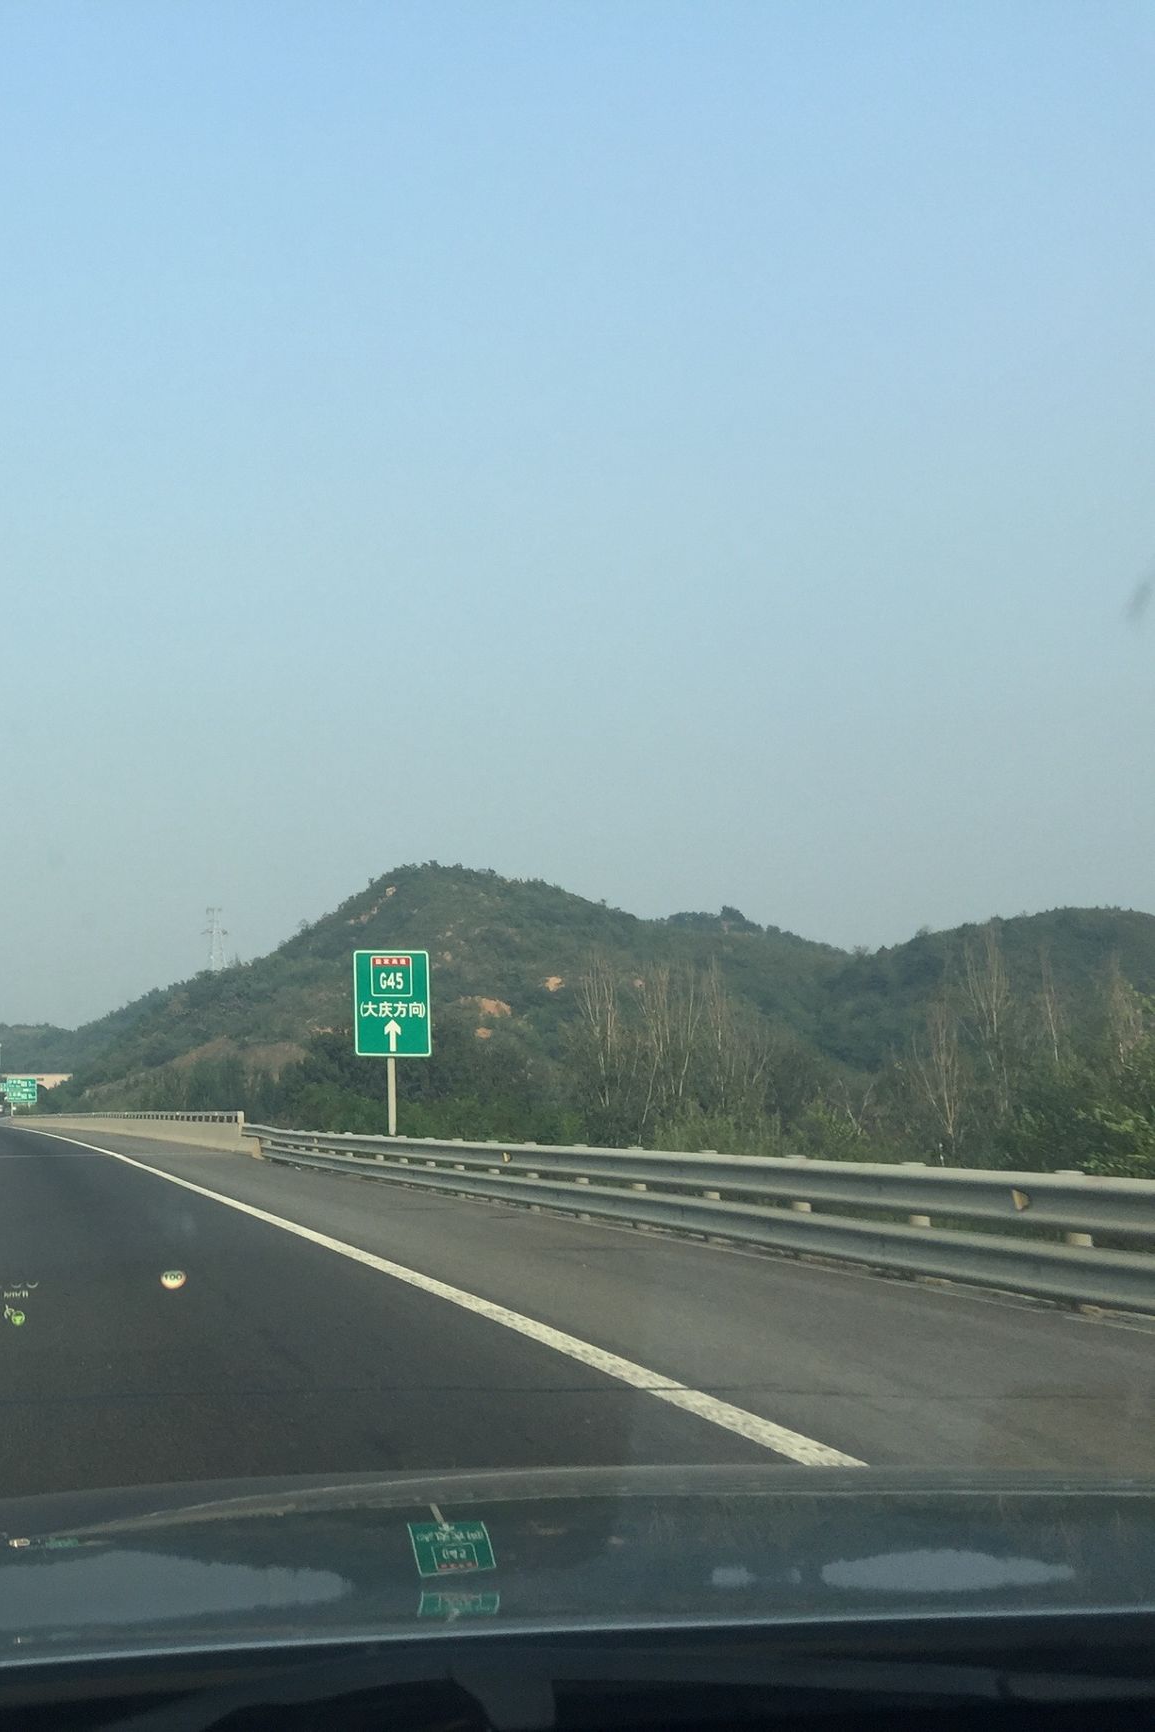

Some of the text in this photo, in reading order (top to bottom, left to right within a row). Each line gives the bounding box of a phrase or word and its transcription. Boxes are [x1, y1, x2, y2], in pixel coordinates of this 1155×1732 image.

[379, 972, 404, 990] G45
[360, 1001, 426, 1018] (大庆方向)
